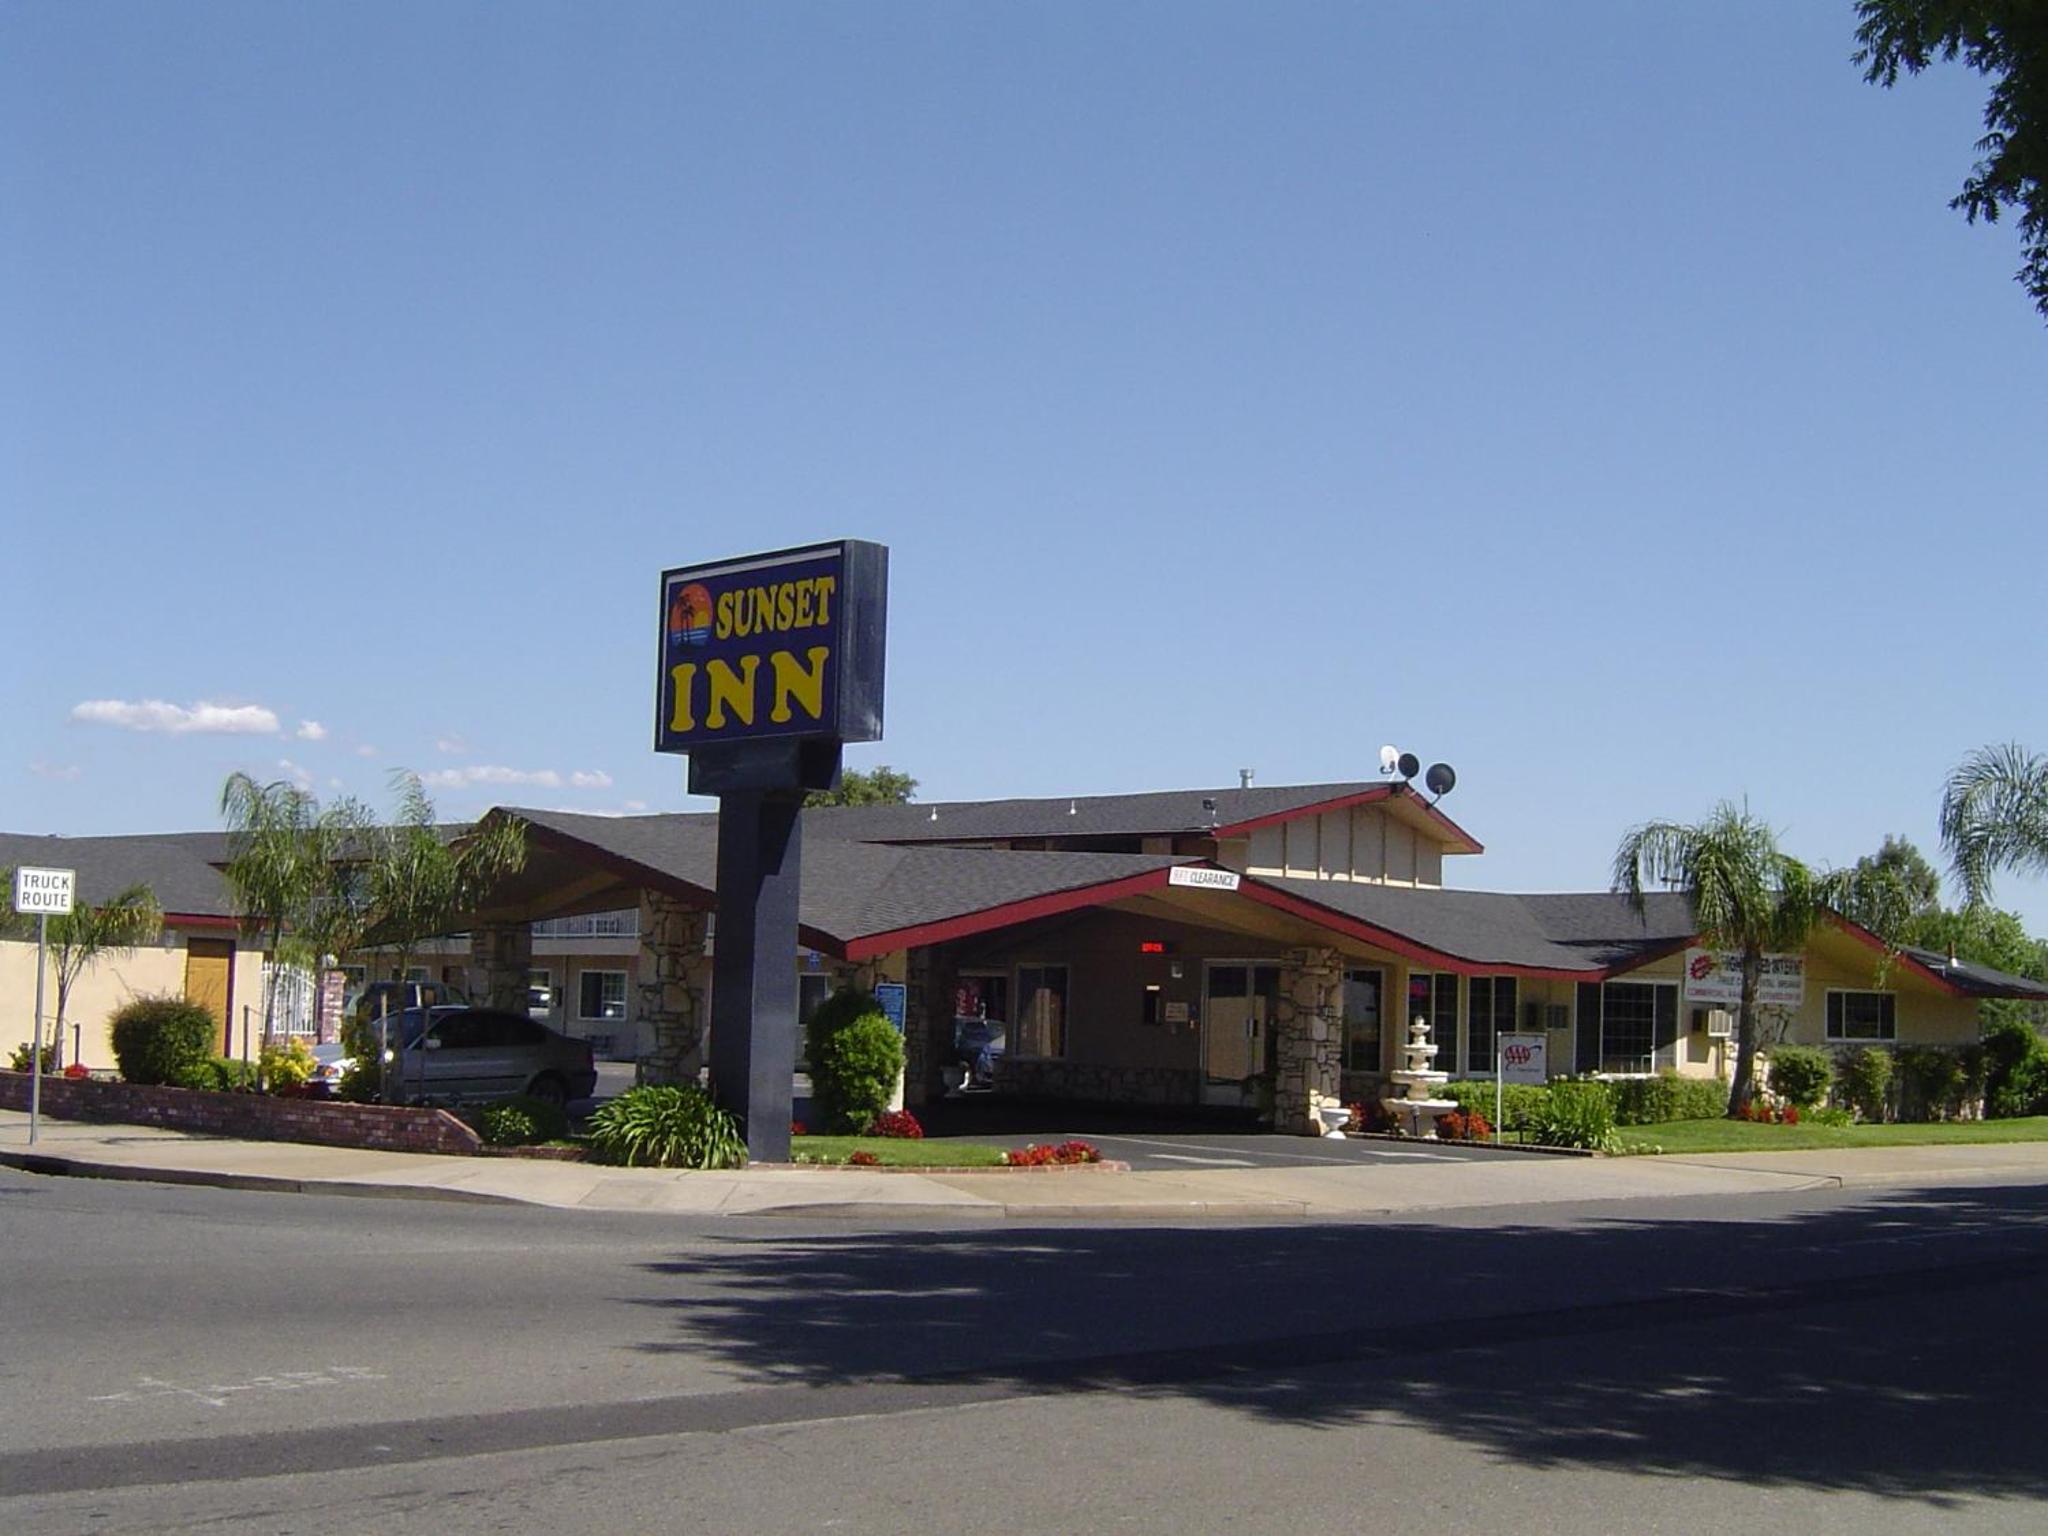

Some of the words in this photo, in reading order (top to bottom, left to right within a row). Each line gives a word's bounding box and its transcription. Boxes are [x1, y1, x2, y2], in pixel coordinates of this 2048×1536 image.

[716, 576, 835, 640] SUNSET
[669, 646, 829, 732] INN
[23, 874, 70, 890] TRUCK
[1190, 871, 1235, 887] CLEARANCE
[22, 891, 68, 908] ROUTE
